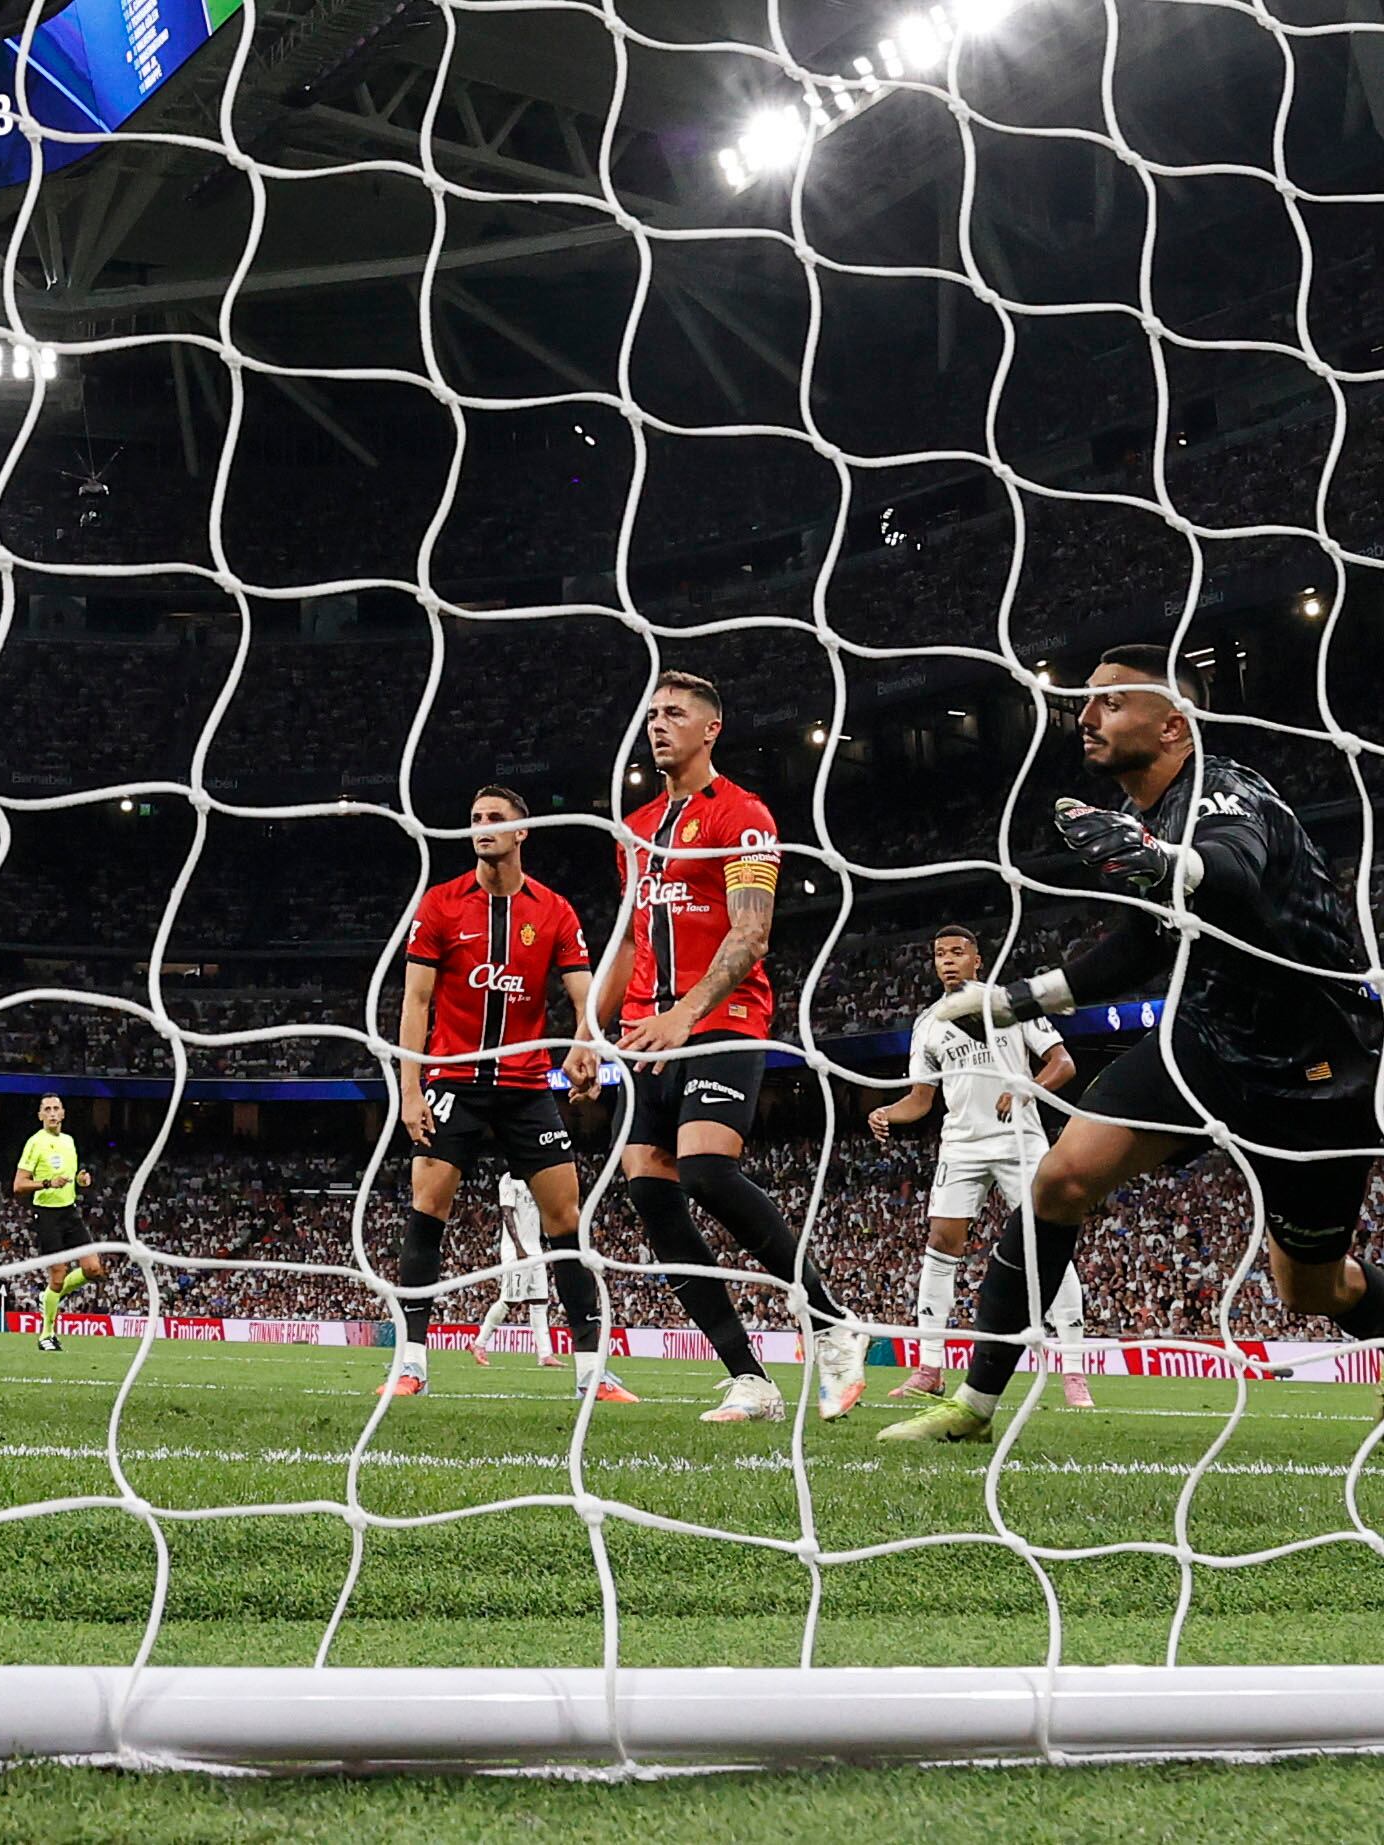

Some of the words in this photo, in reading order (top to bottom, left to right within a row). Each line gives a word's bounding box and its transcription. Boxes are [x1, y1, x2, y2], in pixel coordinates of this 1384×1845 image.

[672, 902, 683, 914] by
[946, 1035, 1008, 1061] Emiraes
[170, 1320, 222, 1342] Emirates
[248, 1321, 285, 1343] STUNNING
[427, 1325, 476, 1350] mirates
[1140, 1346, 1264, 1380] Emirats
